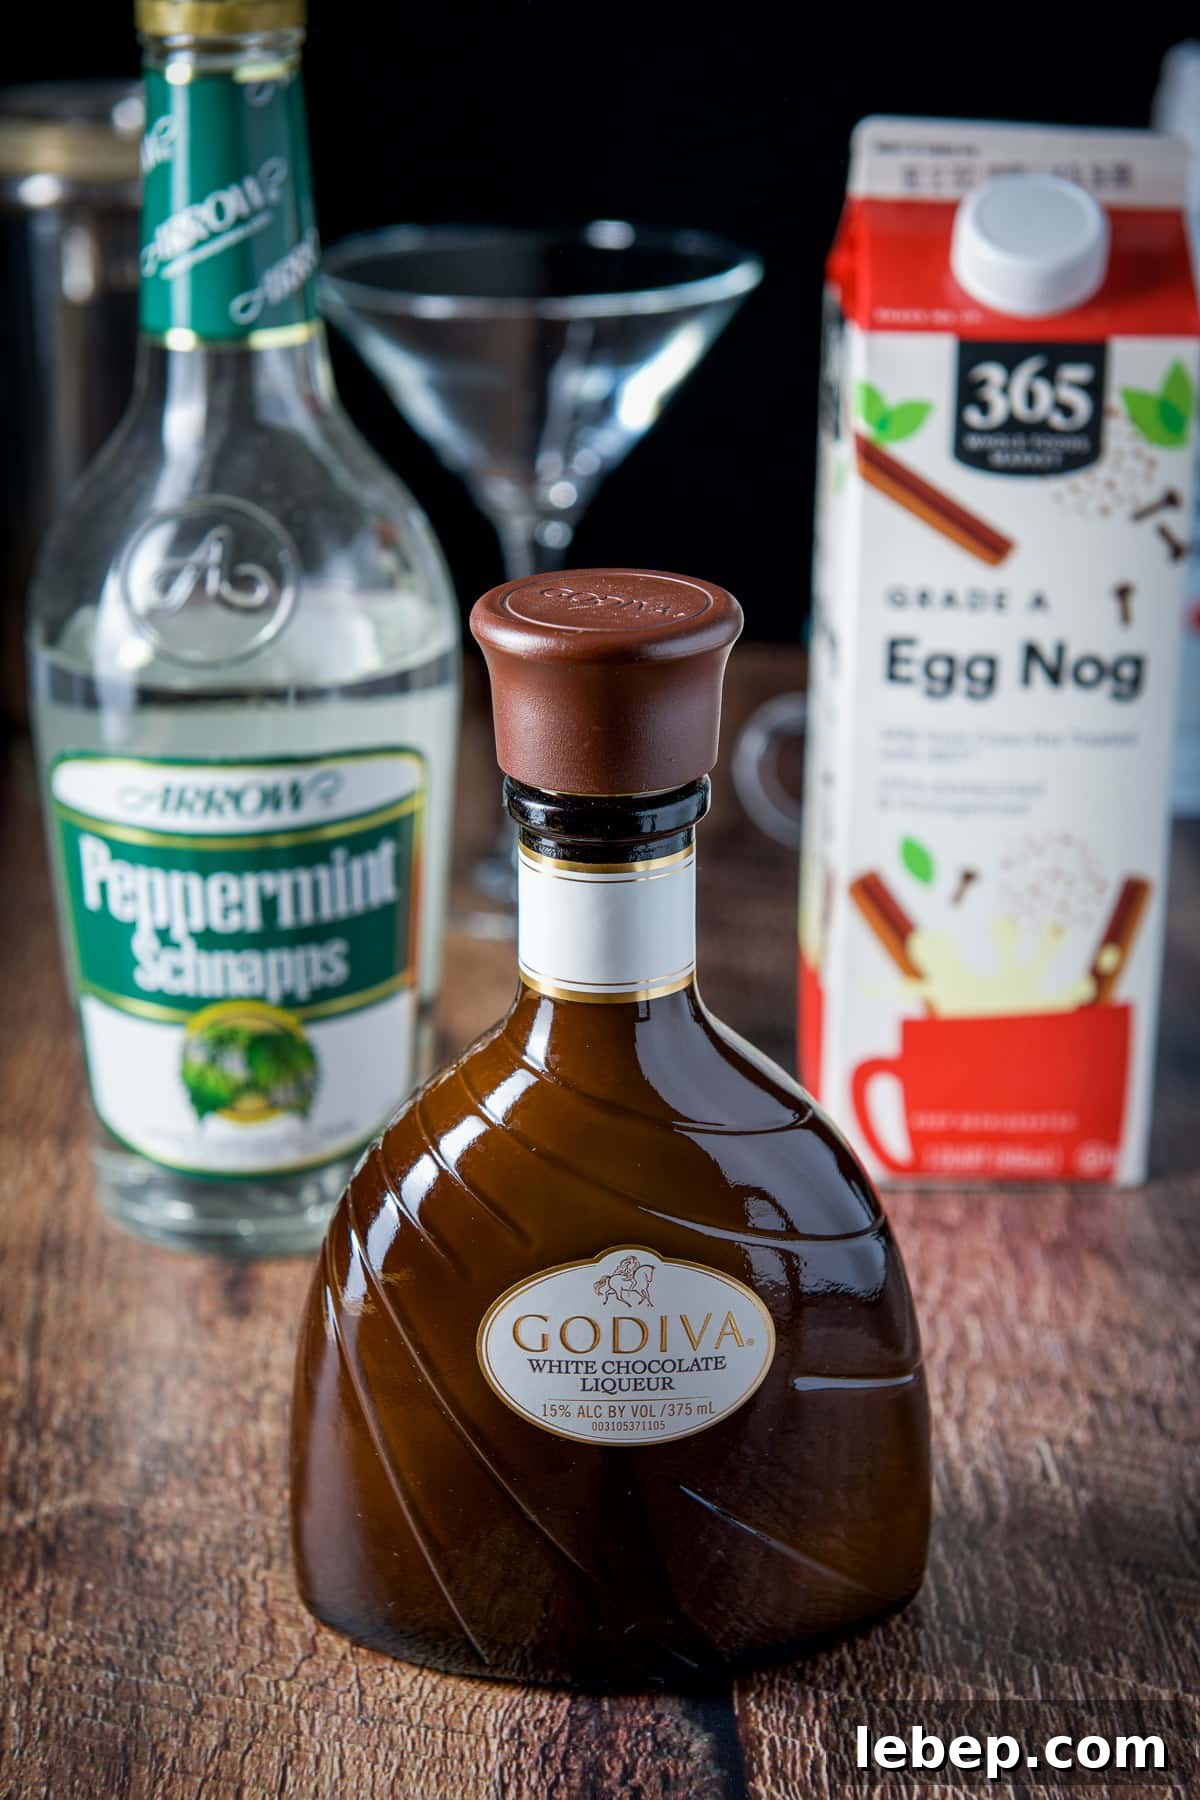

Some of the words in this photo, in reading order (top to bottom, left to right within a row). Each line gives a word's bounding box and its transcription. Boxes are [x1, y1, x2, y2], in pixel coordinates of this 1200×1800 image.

[962, 354, 1096, 432] 365
[886, 585, 1008, 611] GRADE
[1029, 588, 1052, 612] A
[885, 635, 999, 702] Egg
[1020, 637, 1147, 704] Nog
[116, 769, 345, 817] ARROW
[78, 833, 398, 941] Peppermint
[131, 926, 350, 1004] Schnapps
[512, 1311, 744, 1354] GODIVA
[527, 1358, 598, 1375] WHITE
[601, 1355, 727, 1375] CHOCOLATE
[580, 1376, 675, 1395] LIQUEUR
[542, 1403, 571, 1418] 15%
[577, 1404, 602, 1418] ALC
[608, 1404, 625, 1418] BY
[630, 1404, 656, 1418] VOL
[696, 1401, 716, 1416] mL
[591, 1420, 666, 1432] 003105371105
